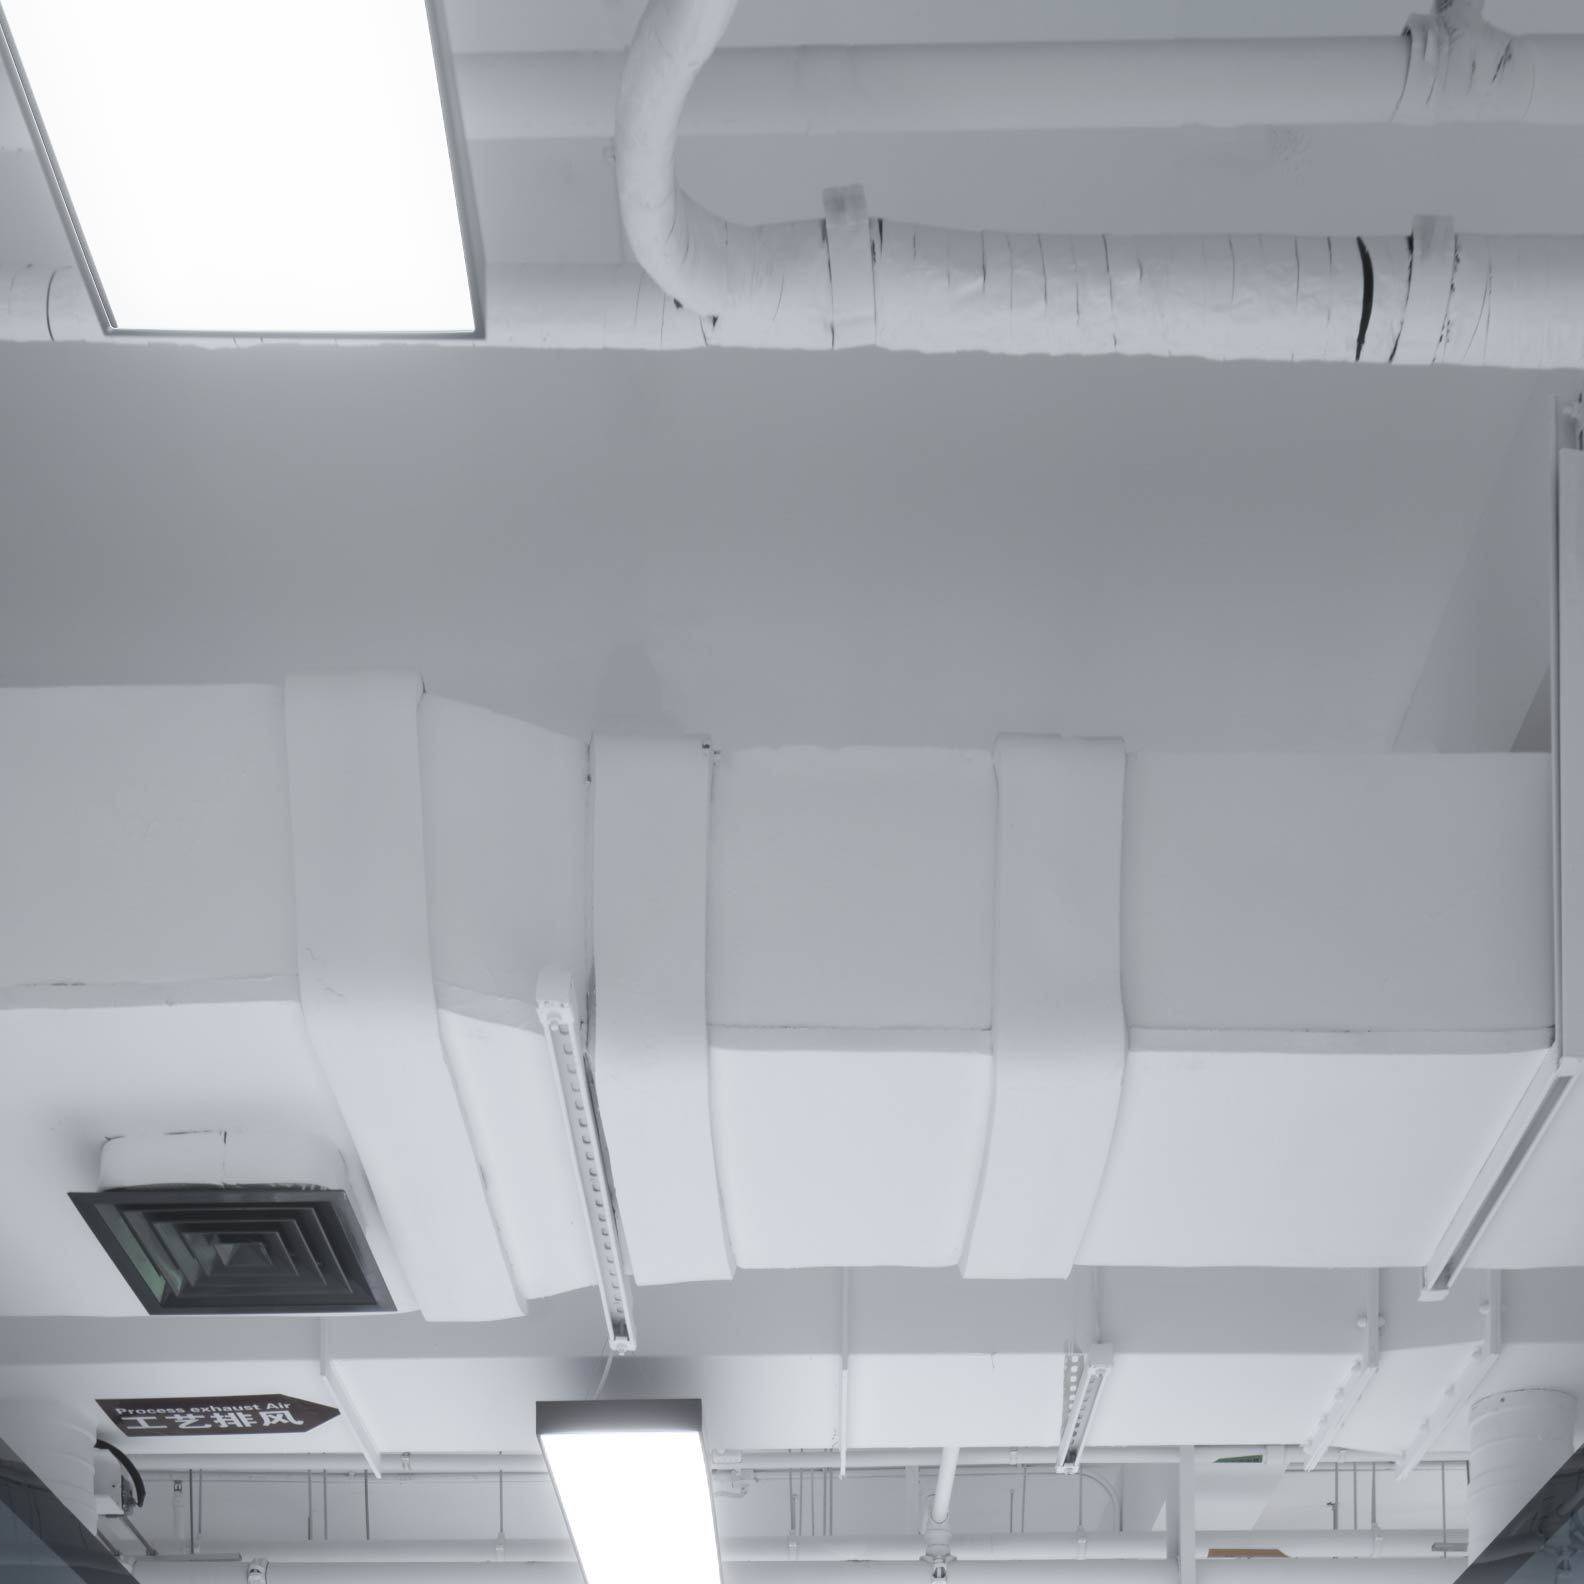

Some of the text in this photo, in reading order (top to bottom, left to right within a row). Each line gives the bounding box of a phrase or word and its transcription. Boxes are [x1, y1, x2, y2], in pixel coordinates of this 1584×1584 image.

[115, 1402, 292, 1415] Process exhaust Air
[120, 1410, 304, 1430] 工艺排风
